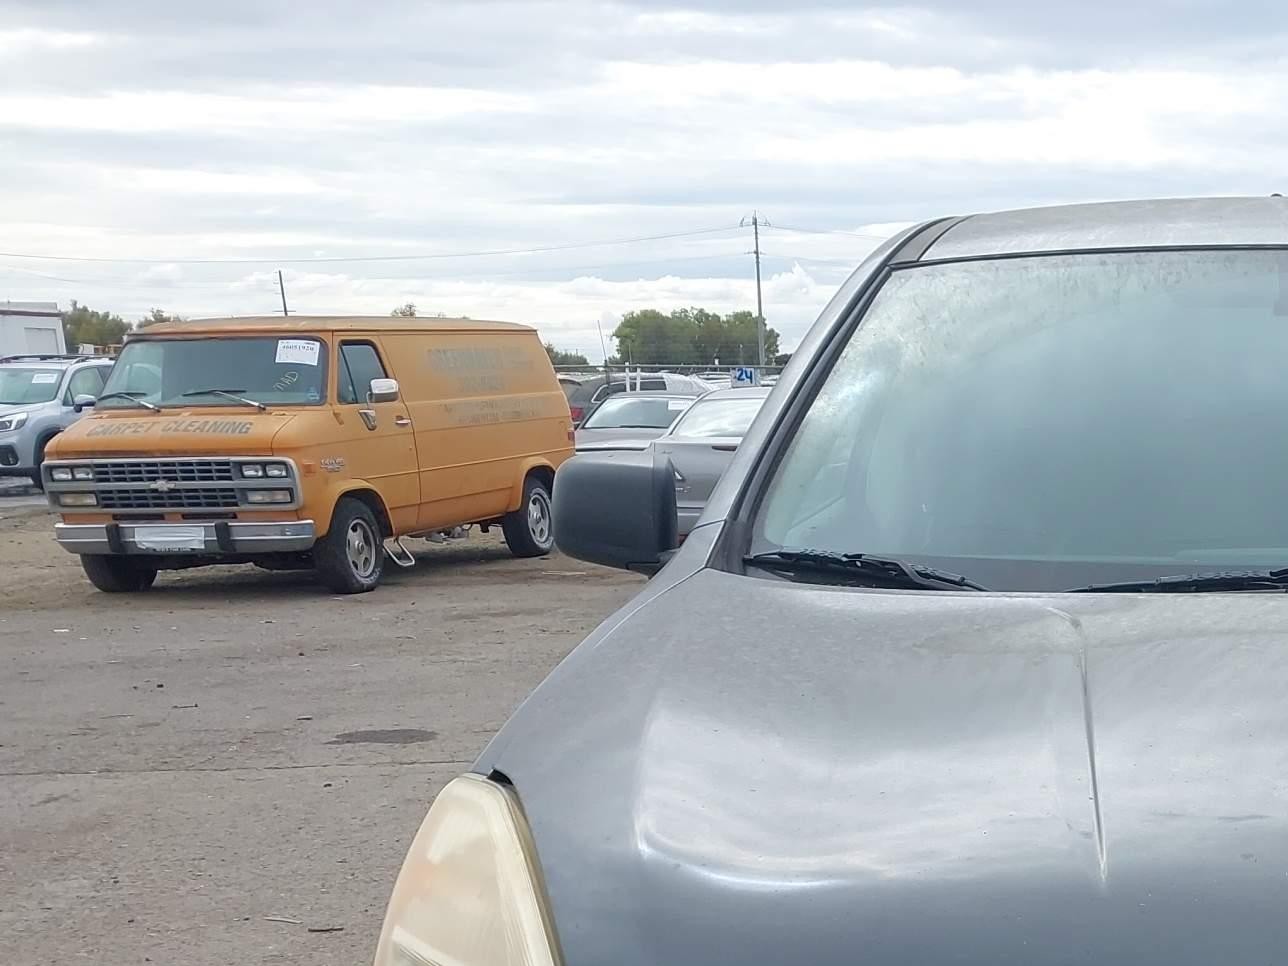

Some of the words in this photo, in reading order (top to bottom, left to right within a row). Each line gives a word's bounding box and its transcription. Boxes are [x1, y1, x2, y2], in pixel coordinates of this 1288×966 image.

[737, 368, 753, 384] 24
[86, 421, 160, 437] CARPET
[161, 420, 253, 434] CLEANING
